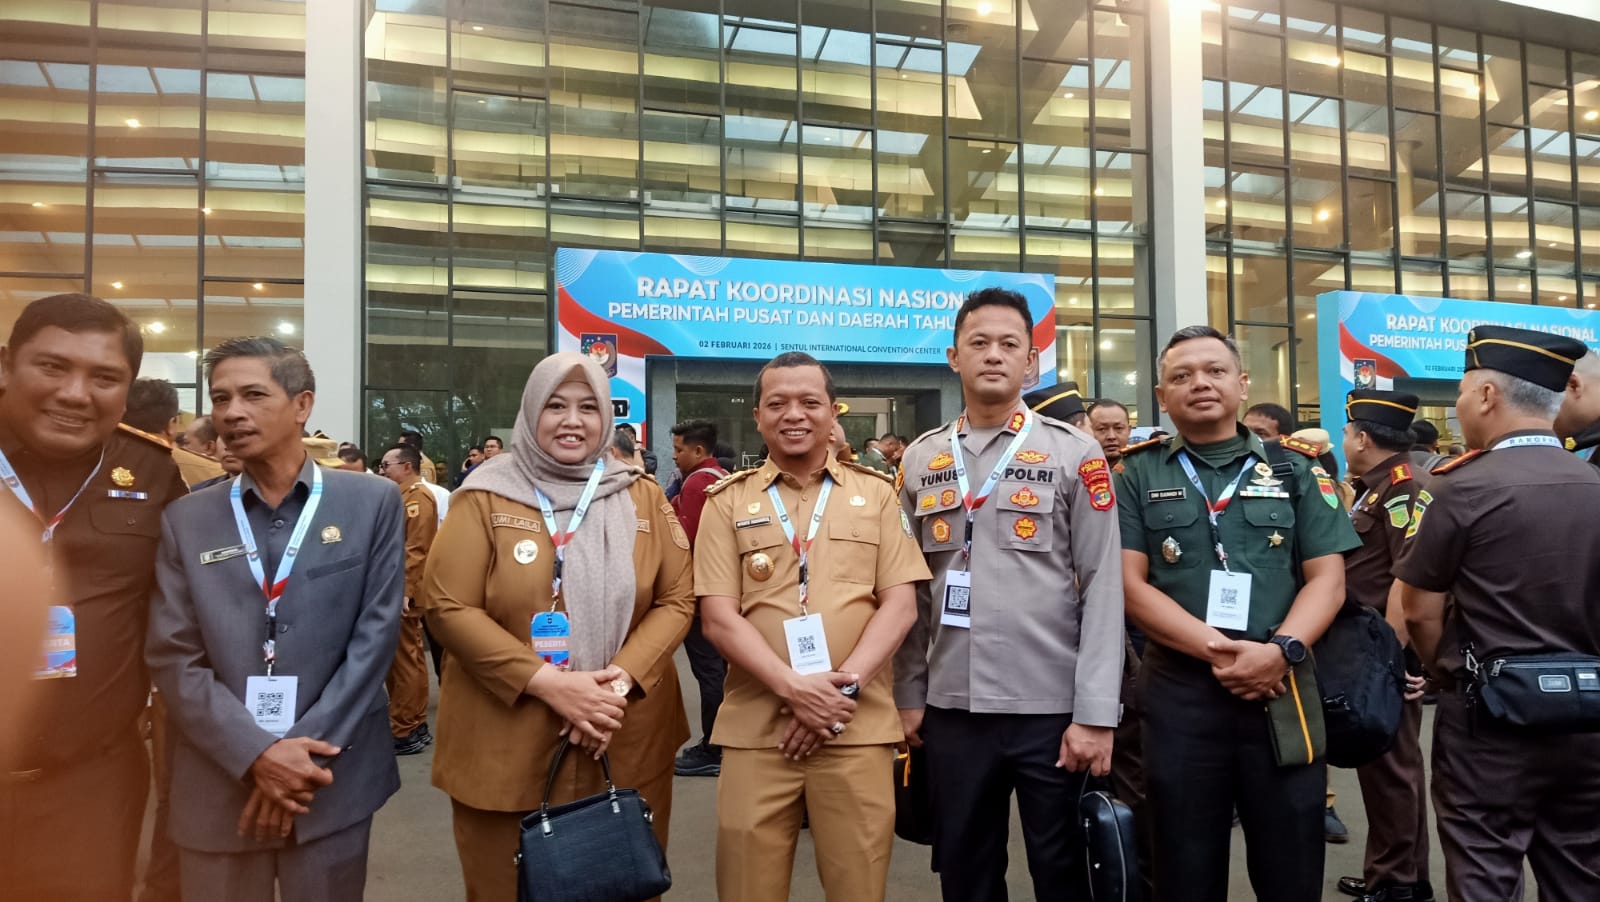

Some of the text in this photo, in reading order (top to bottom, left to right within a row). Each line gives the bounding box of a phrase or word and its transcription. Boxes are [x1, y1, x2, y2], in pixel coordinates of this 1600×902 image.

[637, 276, 964, 310] RAPAT KOORDINASI NASION
[608, 301, 956, 331] PEMERINTAH PUSAT DAN DAERAH TAHU
[1386, 313, 1436, 332] RAPAT
[699, 340, 941, 355] 02 FEBRUARI 2026 SENTUL INTERNATIONAL CONVENTION CENTER
[1369, 333, 1467, 352] PEMERINTAH PUS
[1004, 467, 1053, 483] POLRI
[492, 514, 539, 530] UMI LAILA
